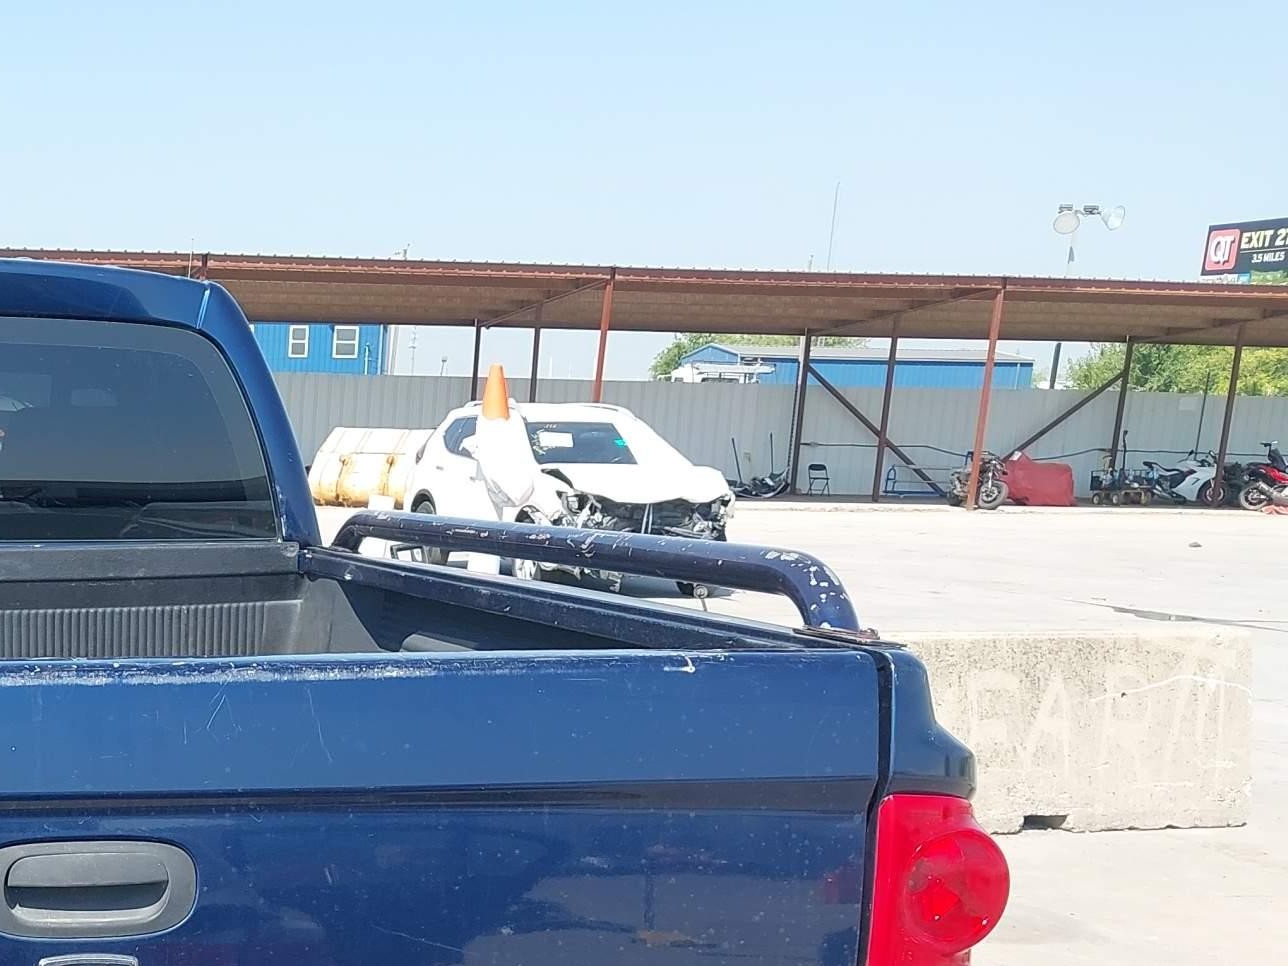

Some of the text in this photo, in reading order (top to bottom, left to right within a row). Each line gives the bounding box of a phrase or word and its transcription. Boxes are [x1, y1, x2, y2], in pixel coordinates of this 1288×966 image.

[1240, 229, 1274, 249] EXIT
[1210, 235, 1235, 266] QT
[1251, 251, 1286, 263] 3.5 MILES
